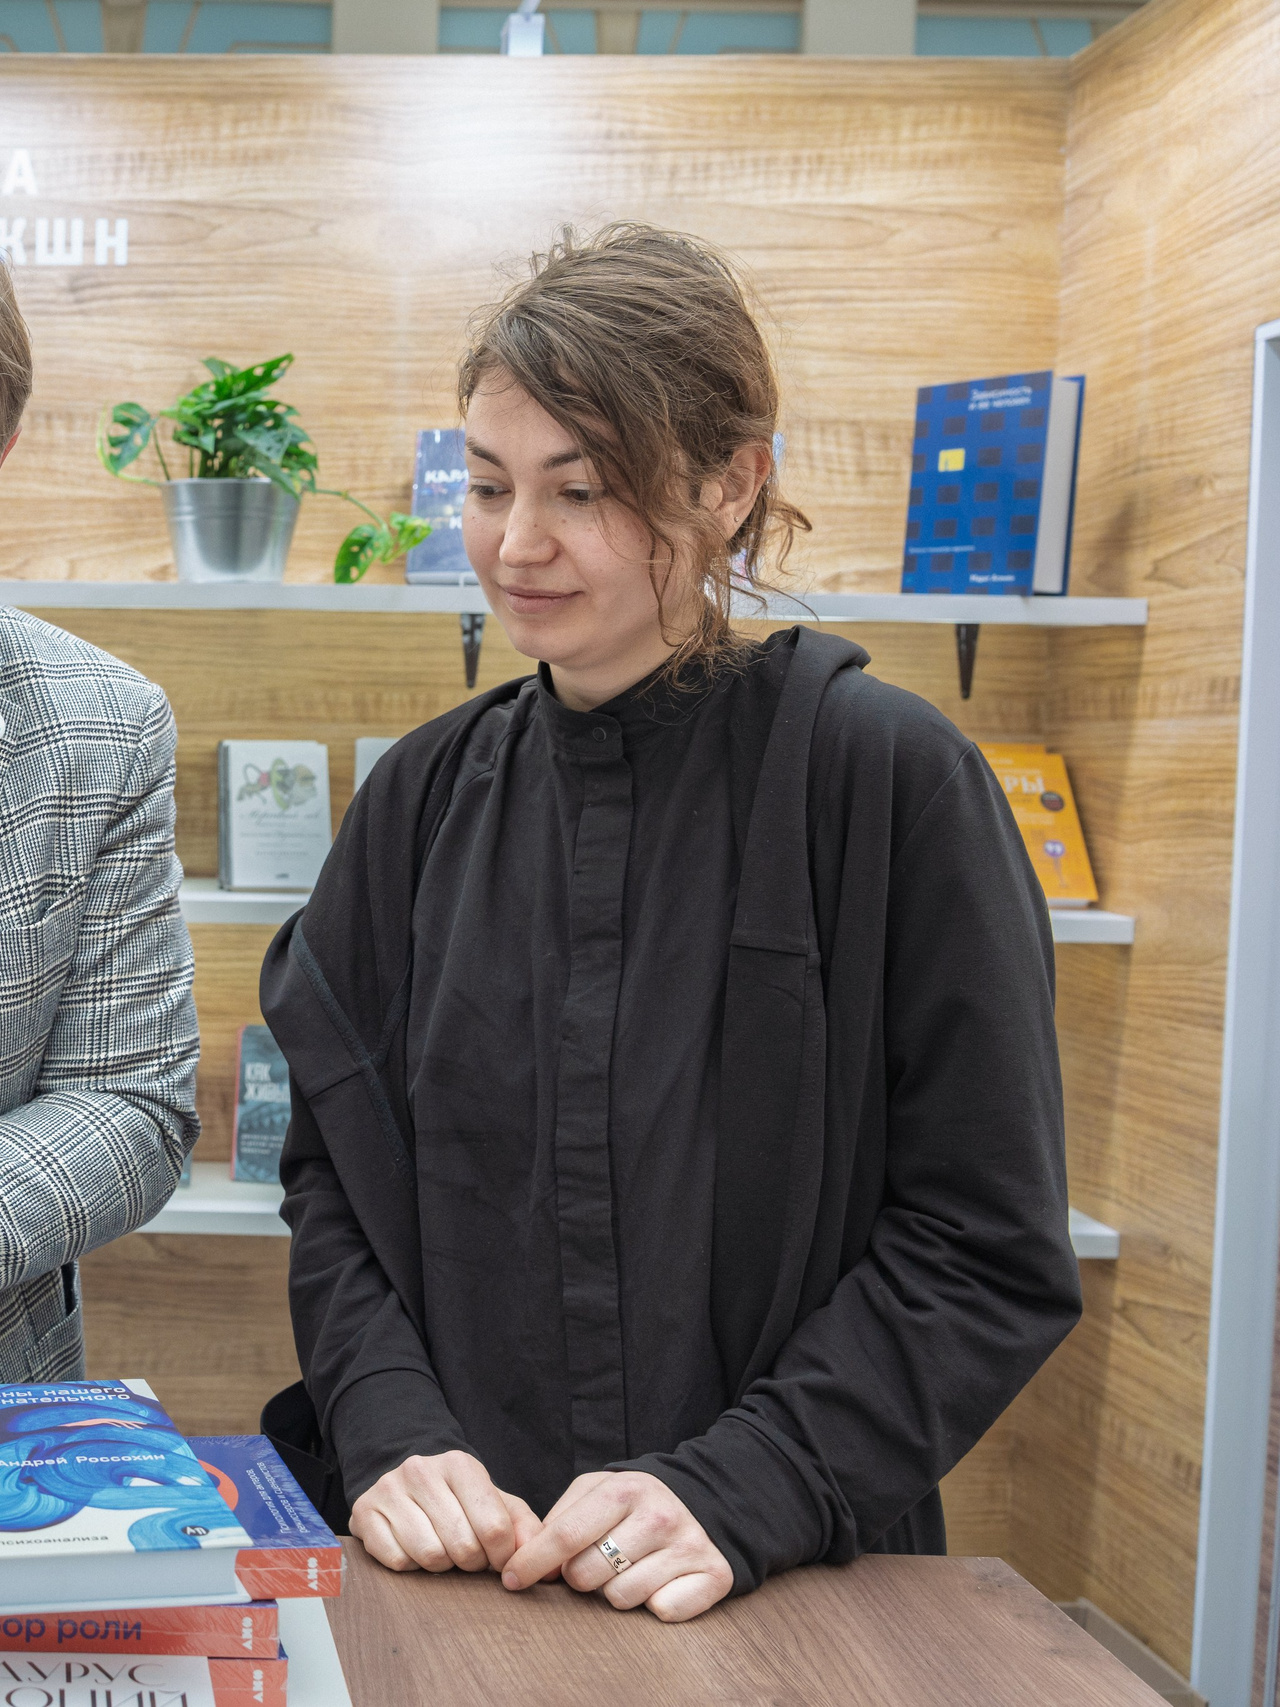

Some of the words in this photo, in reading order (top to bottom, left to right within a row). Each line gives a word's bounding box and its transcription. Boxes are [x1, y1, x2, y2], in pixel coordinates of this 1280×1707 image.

[43, 1387, 126, 1396] нашего
[75, 1454, 166, 1464] Россохин
[57, 1618, 142, 1643] роли
